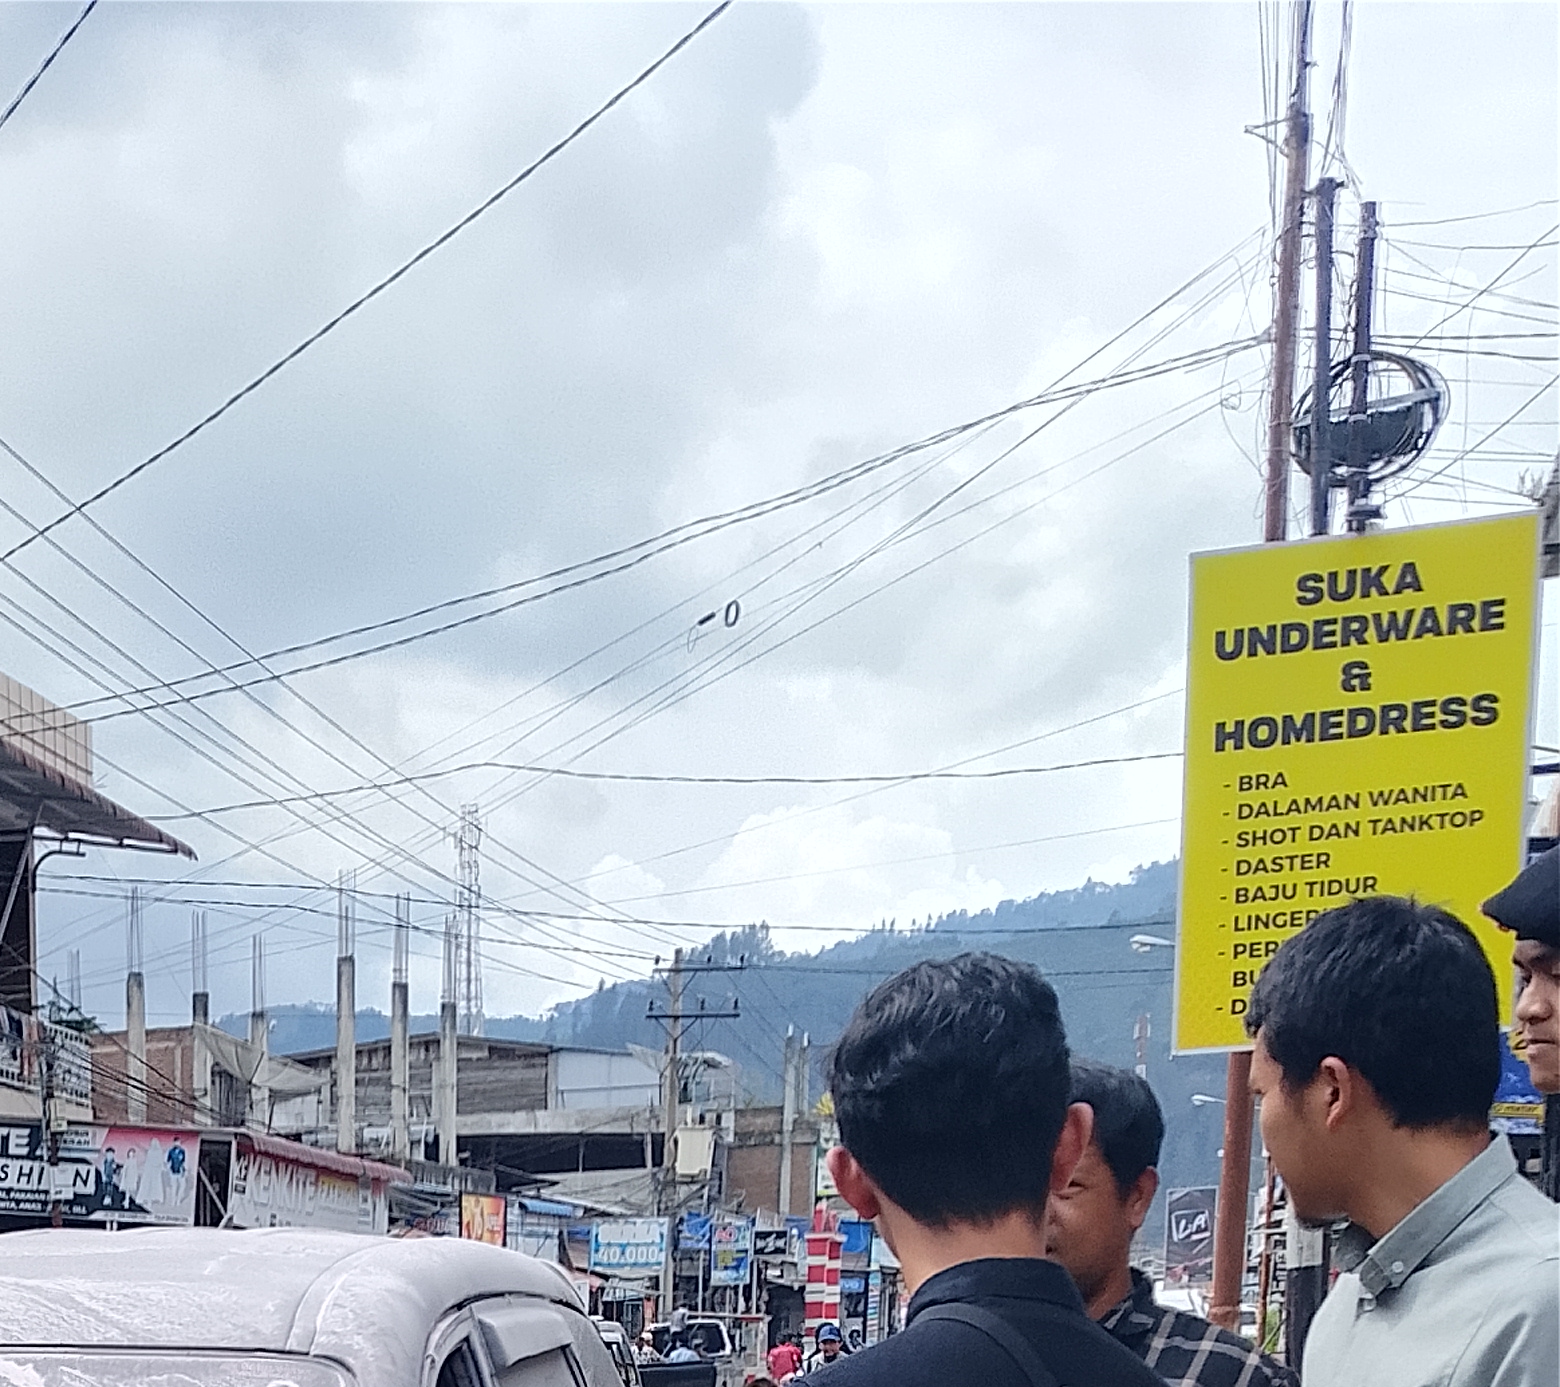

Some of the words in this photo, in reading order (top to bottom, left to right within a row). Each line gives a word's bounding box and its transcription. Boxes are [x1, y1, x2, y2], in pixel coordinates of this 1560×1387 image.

[1296, 561, 1423, 606] SUKA
[1214, 598, 1506, 661] UNDERWARE
[1341, 660, 1372, 692] &
[1214, 693, 1500, 752] HOMEDRESS
[1237, 771, 1288, 792] BRA
[1237, 792, 1361, 820] DALAMAN
[1368, 782, 1468, 808] WANITA
[1235, 826, 1302, 848] SHOT
[1308, 821, 1360, 842] DAN
[1368, 809, 1484, 836] TANKTOP
[1235, 852, 1331, 877] DASTER
[1234, 883, 1298, 904] BAJU
[1304, 875, 1378, 898] TIDUR
[1233, 908, 1326, 932] LINGER
[1233, 940, 1282, 960] PER
